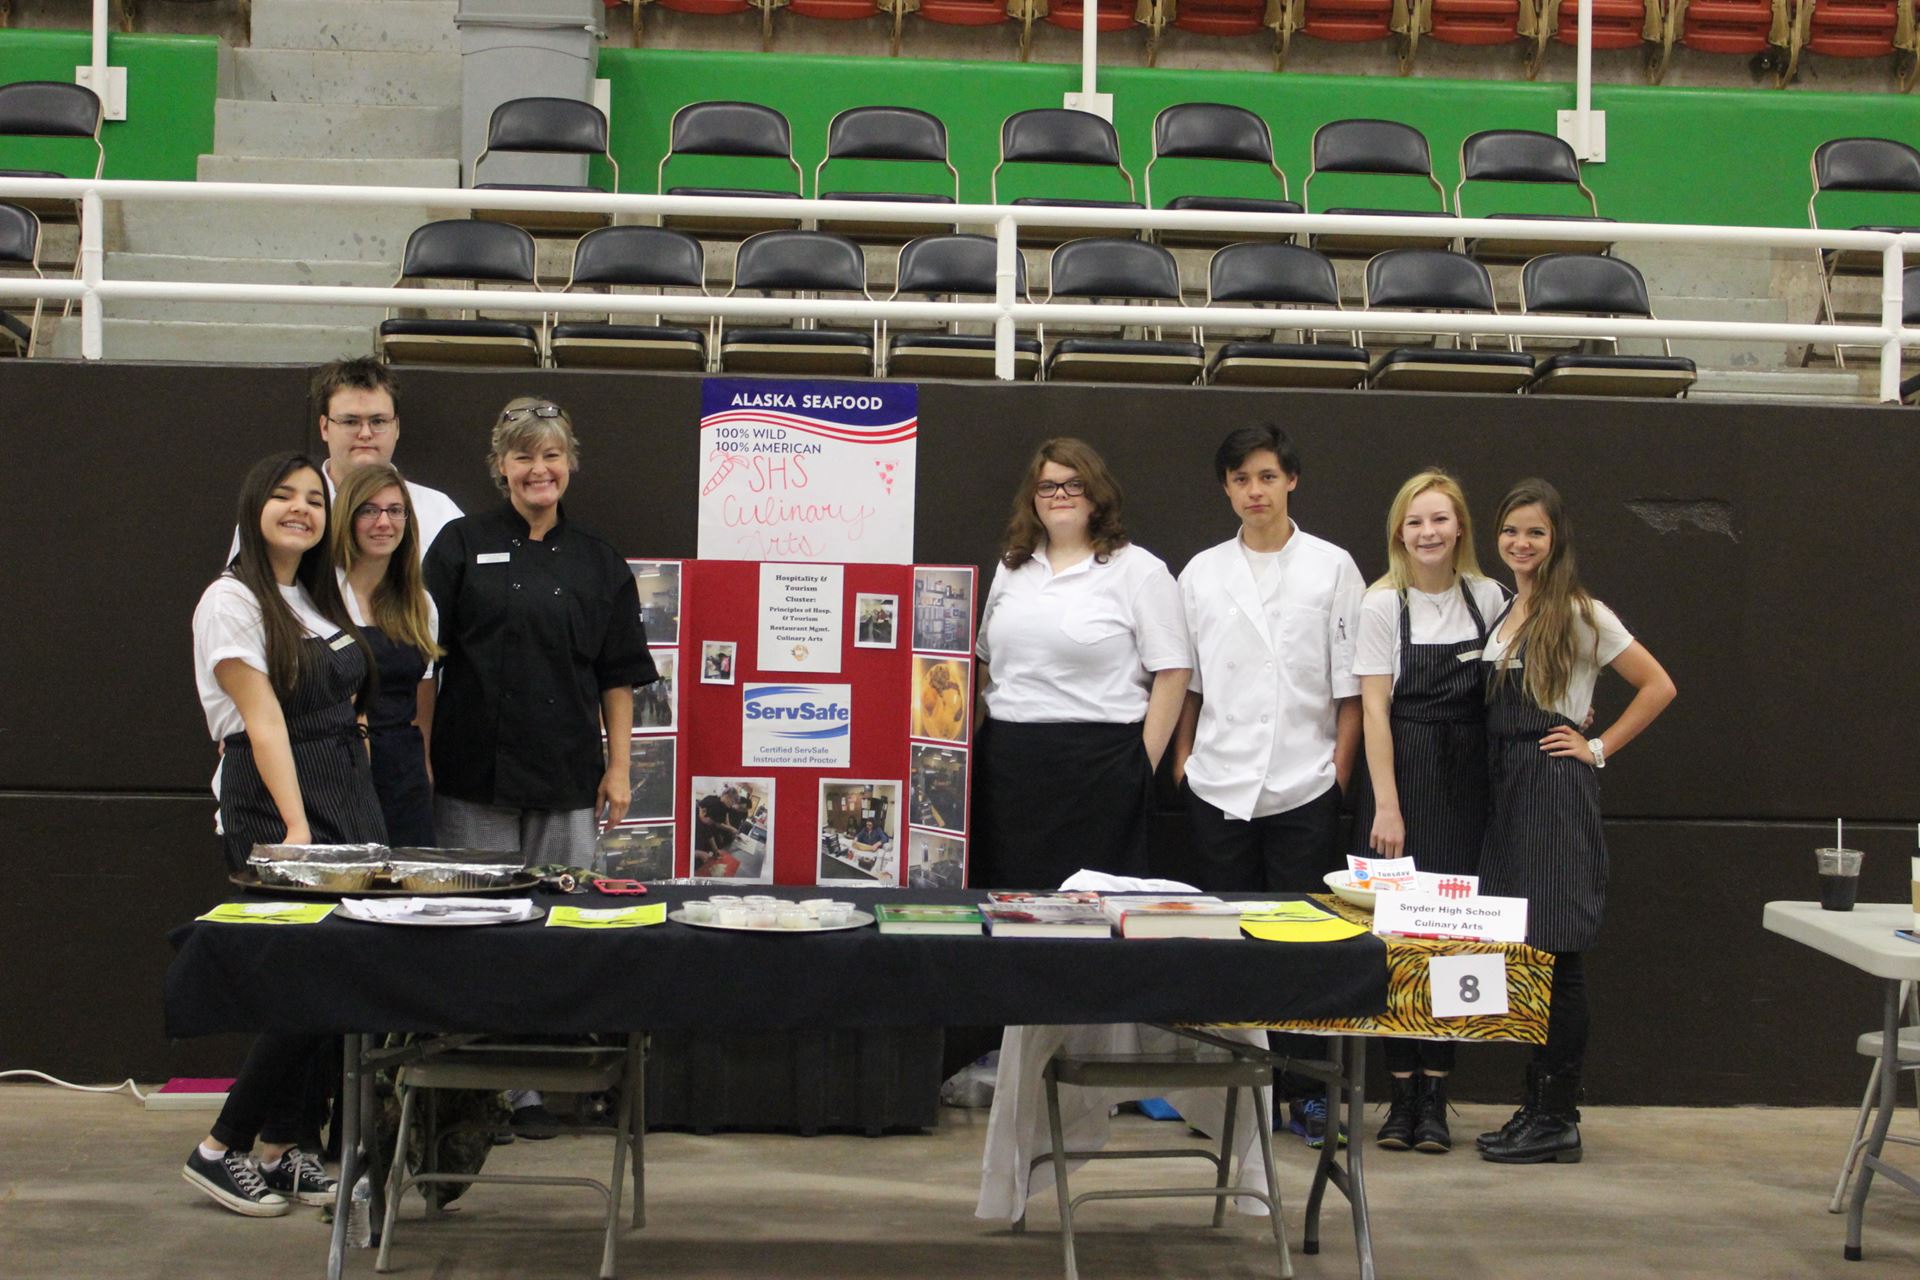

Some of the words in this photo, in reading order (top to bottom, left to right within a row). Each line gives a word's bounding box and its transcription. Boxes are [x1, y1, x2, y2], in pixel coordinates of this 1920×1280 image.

[731, 393, 796, 408] ALASKA
[802, 394, 883, 410] SEAFOOD
[715, 428, 750, 439] 100%
[752, 428, 787, 440] WILD
[715, 441, 750, 453] 100%
[752, 443, 822, 455] AMERICAN
[748, 454, 809, 493] SHS
[723, 494, 876, 541] Culinary
[737, 531, 826, 561] Arts
[775, 574, 818, 583] Hospitality
[784, 584, 818, 592] Tourism
[813, 607, 832, 615] Hosp.
[809, 625, 830, 633] Mgmt.
[745, 701, 849, 720] ServSafe
[760, 746, 792, 754] Certified
[794, 746, 829, 754] ServSafe
[792, 756, 807, 764] and
[809, 756, 837, 764] Proctor
[1400, 903, 1435, 914] Snyder
[1438, 906, 1463, 916] High
[1465, 907, 1502, 917] School
[1414, 919, 1459, 930] Culinary
[1460, 921, 1484, 931] Arts
[1458, 974, 1481, 1003] 8
